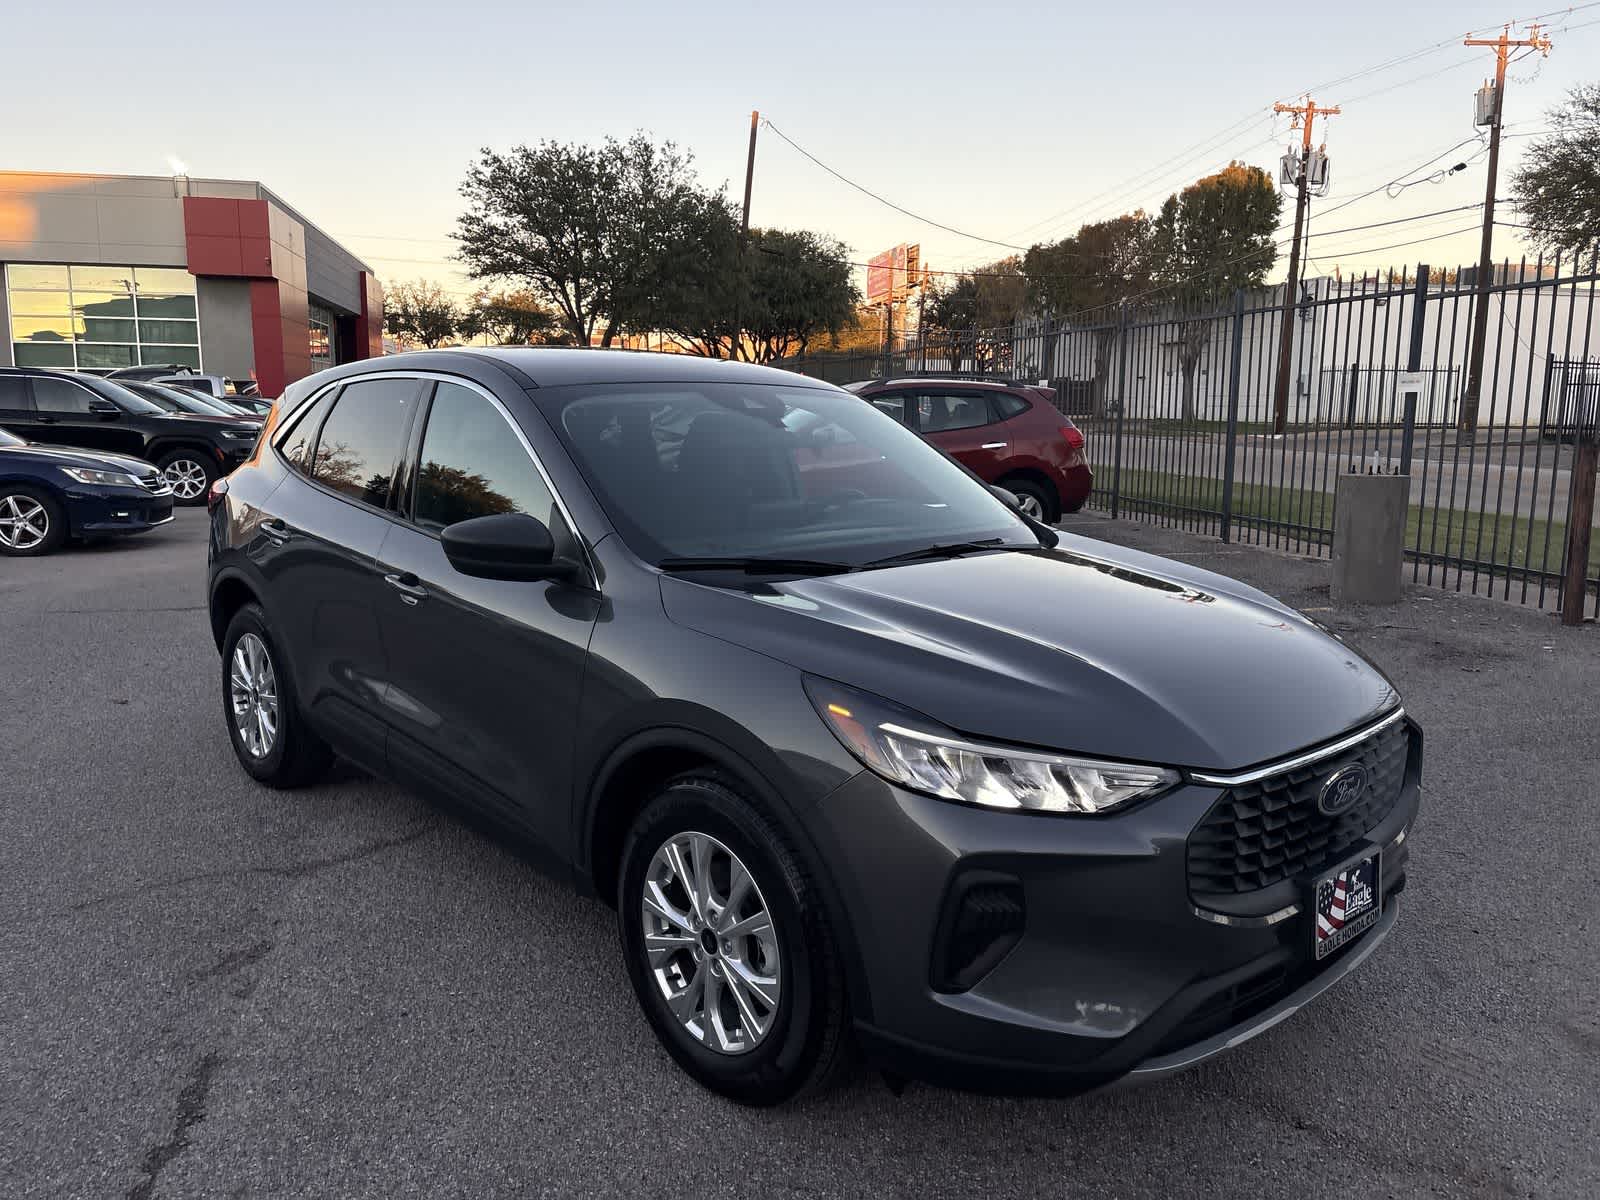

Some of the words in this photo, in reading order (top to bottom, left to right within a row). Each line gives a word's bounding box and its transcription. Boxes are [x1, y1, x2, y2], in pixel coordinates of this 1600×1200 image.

[1334, 777, 1360, 806] Ford
[1346, 885, 1372, 911] Eagle
[1319, 936, 1340, 955] EAGLE
